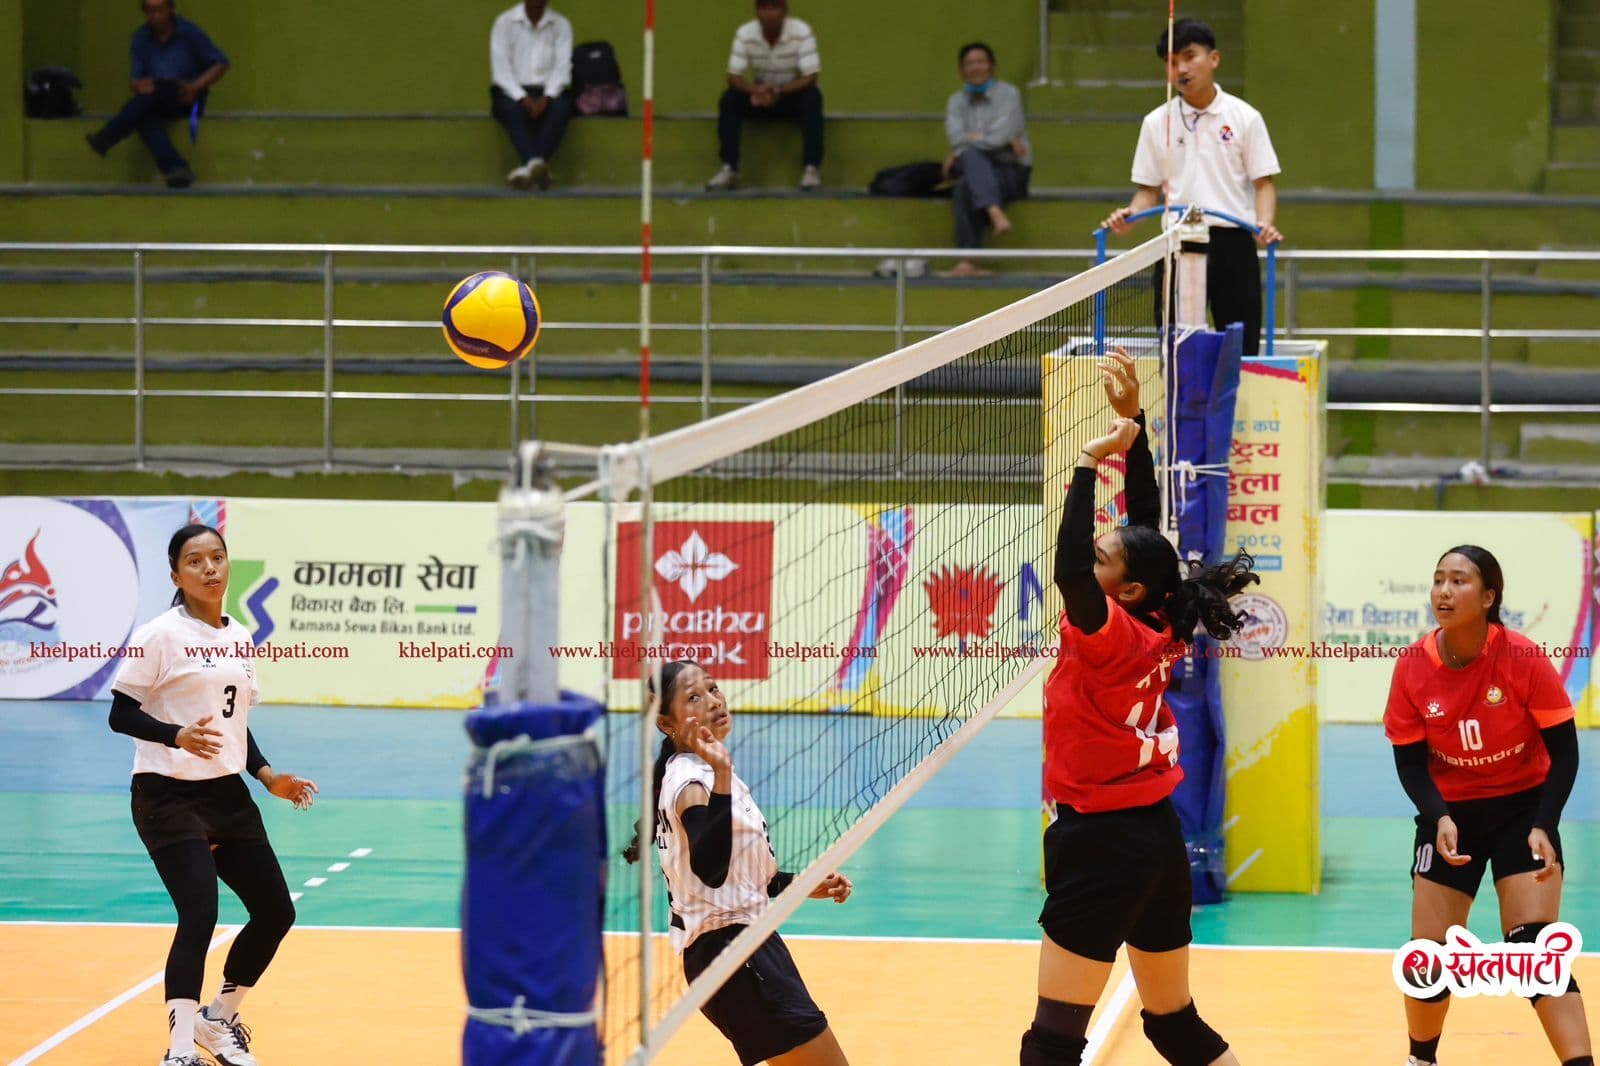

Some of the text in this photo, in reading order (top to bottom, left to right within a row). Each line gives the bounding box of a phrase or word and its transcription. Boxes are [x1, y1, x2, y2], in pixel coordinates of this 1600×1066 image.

[1228, 470, 1280, 496] हिला
[1227, 503, 1280, 525] बल
[294, 554, 479, 591] कामना सेवा
[291, 593, 343, 613] विकास
[1321, 602, 1354, 624] रिमा
[290, 619, 475, 636] Kamana Sewa Bikas Bank Ltd.
[222, 685, 237, 718] 3
[1458, 719, 1483, 751] 10
[1413, 843, 1433, 873] 10
